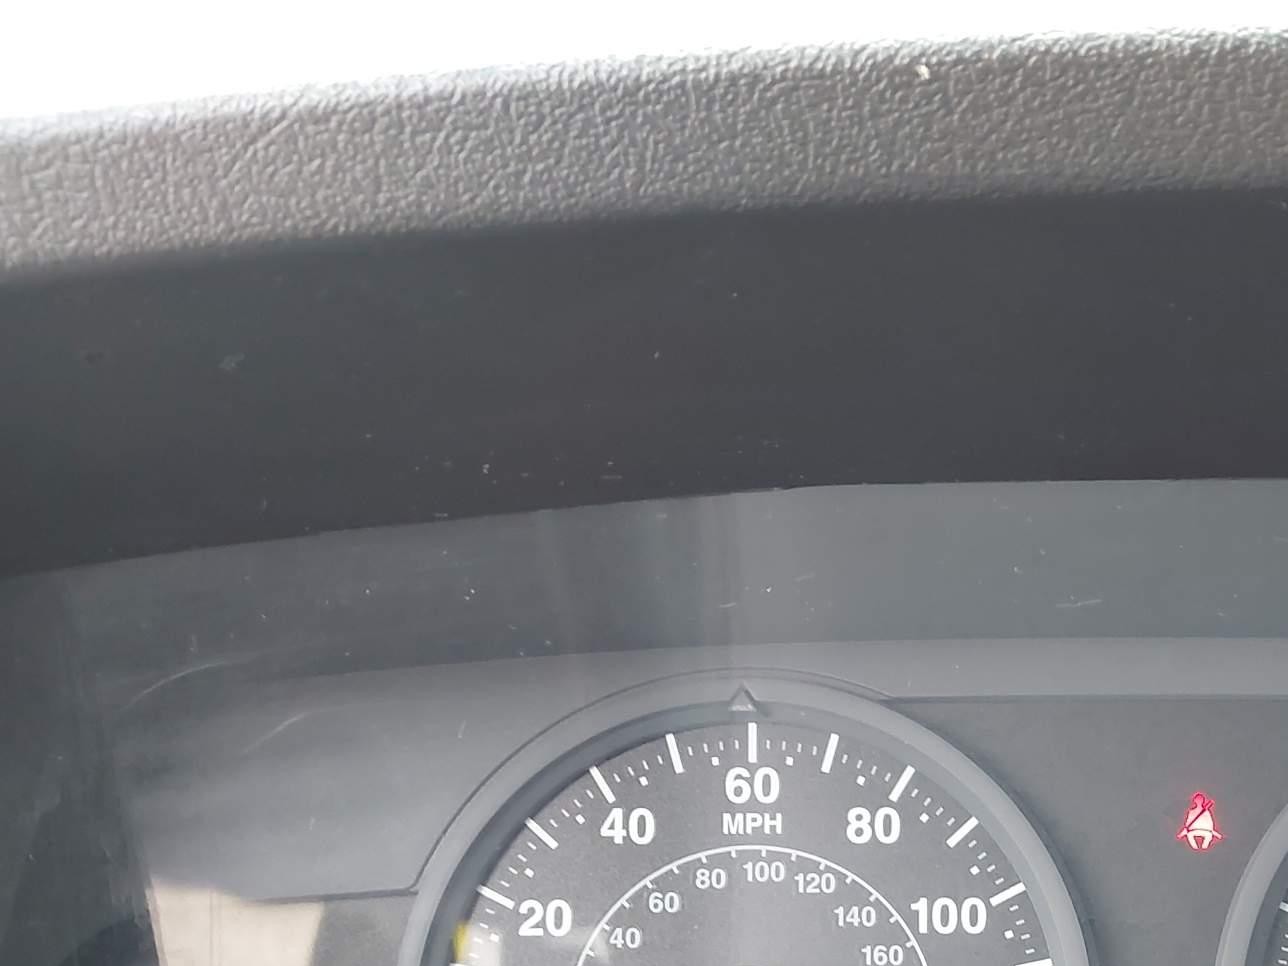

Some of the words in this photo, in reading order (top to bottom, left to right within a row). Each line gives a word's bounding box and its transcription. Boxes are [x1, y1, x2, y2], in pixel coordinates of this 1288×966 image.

[724, 766, 781, 804] 60
[600, 807, 656, 845] 40
[721, 812, 783, 836] MPH
[845, 806, 902, 845] 80
[695, 868, 728, 890] 80
[742, 861, 787, 883] 100
[793, 872, 837, 895] 120
[647, 891, 681, 914] 60
[517, 899, 574, 937] 20
[833, 905, 877, 929] 140
[909, 897, 988, 935] 100
[608, 926, 642, 949] 40
[861, 944, 905, 966] 160
